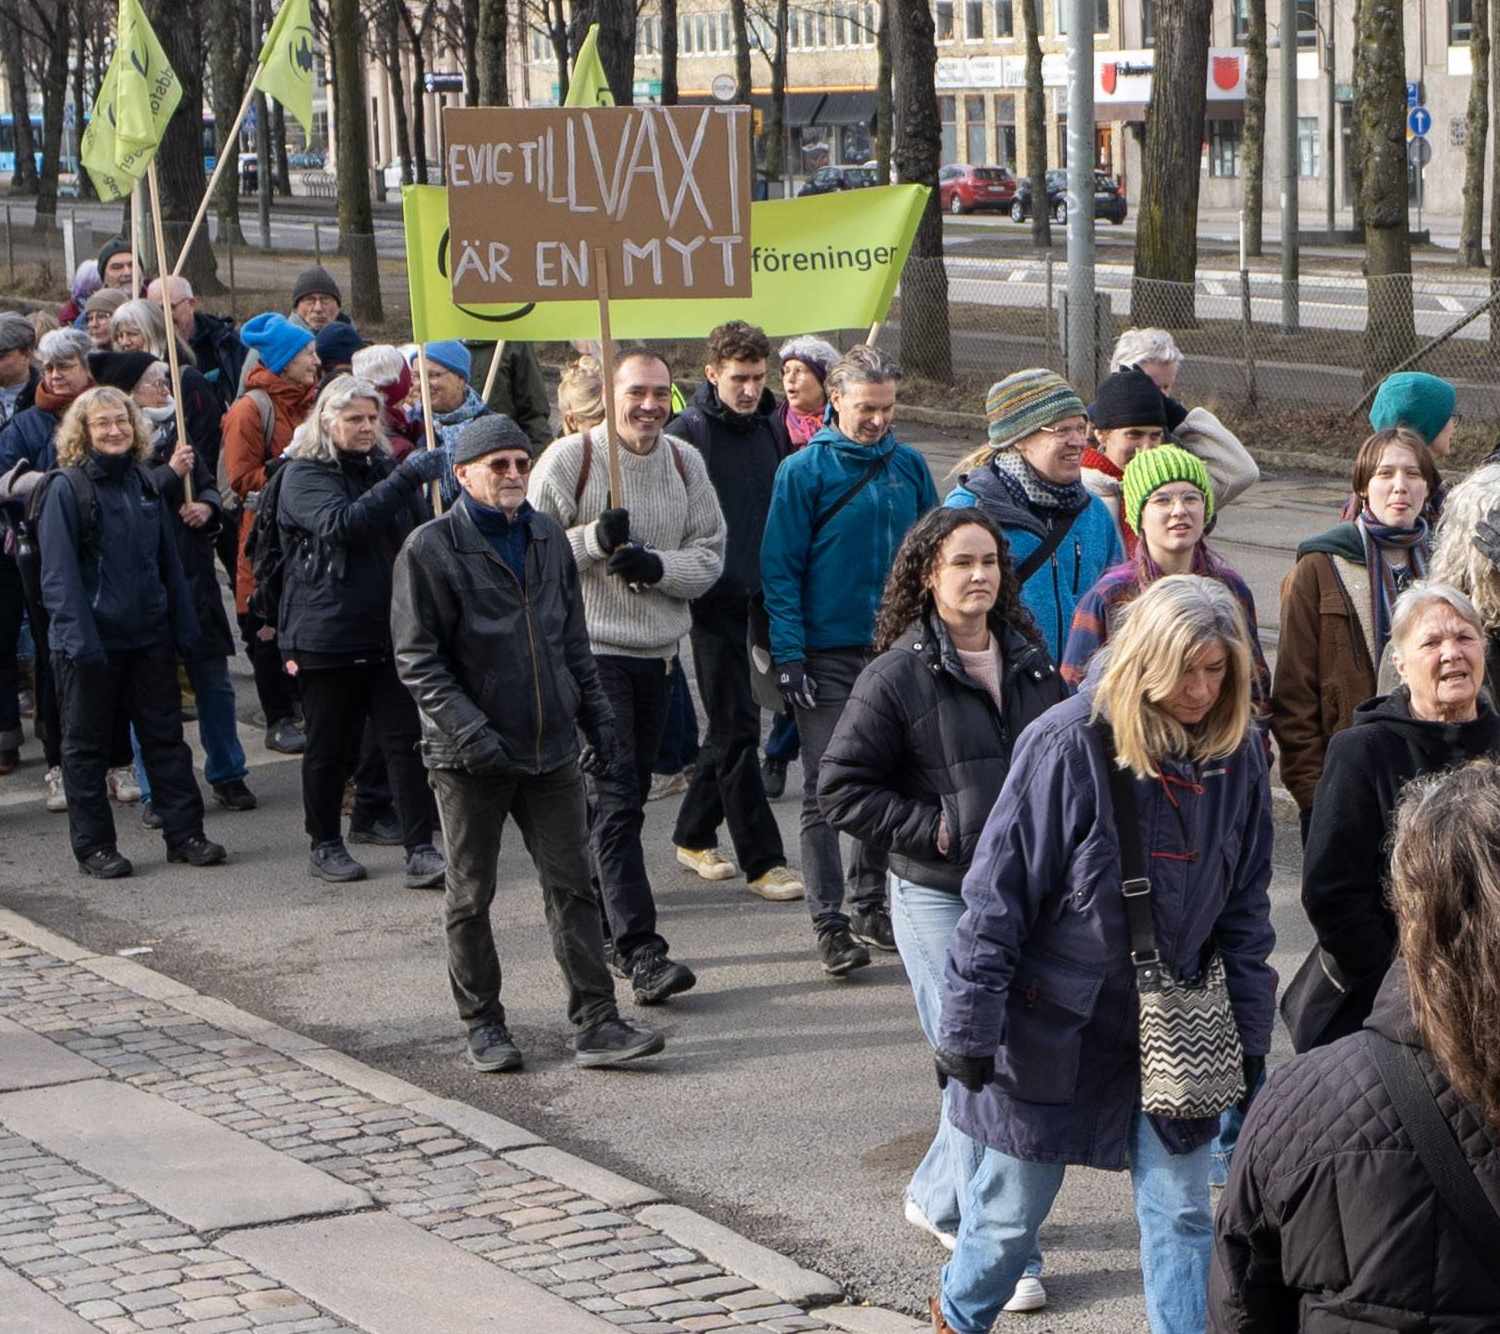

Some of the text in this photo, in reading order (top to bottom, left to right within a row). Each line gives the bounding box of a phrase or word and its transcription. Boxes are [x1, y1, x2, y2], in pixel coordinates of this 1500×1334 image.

[449, 105, 751, 234] EVIG TILLVÄXT
[453, 235, 744, 288] ÄR EN MYT
